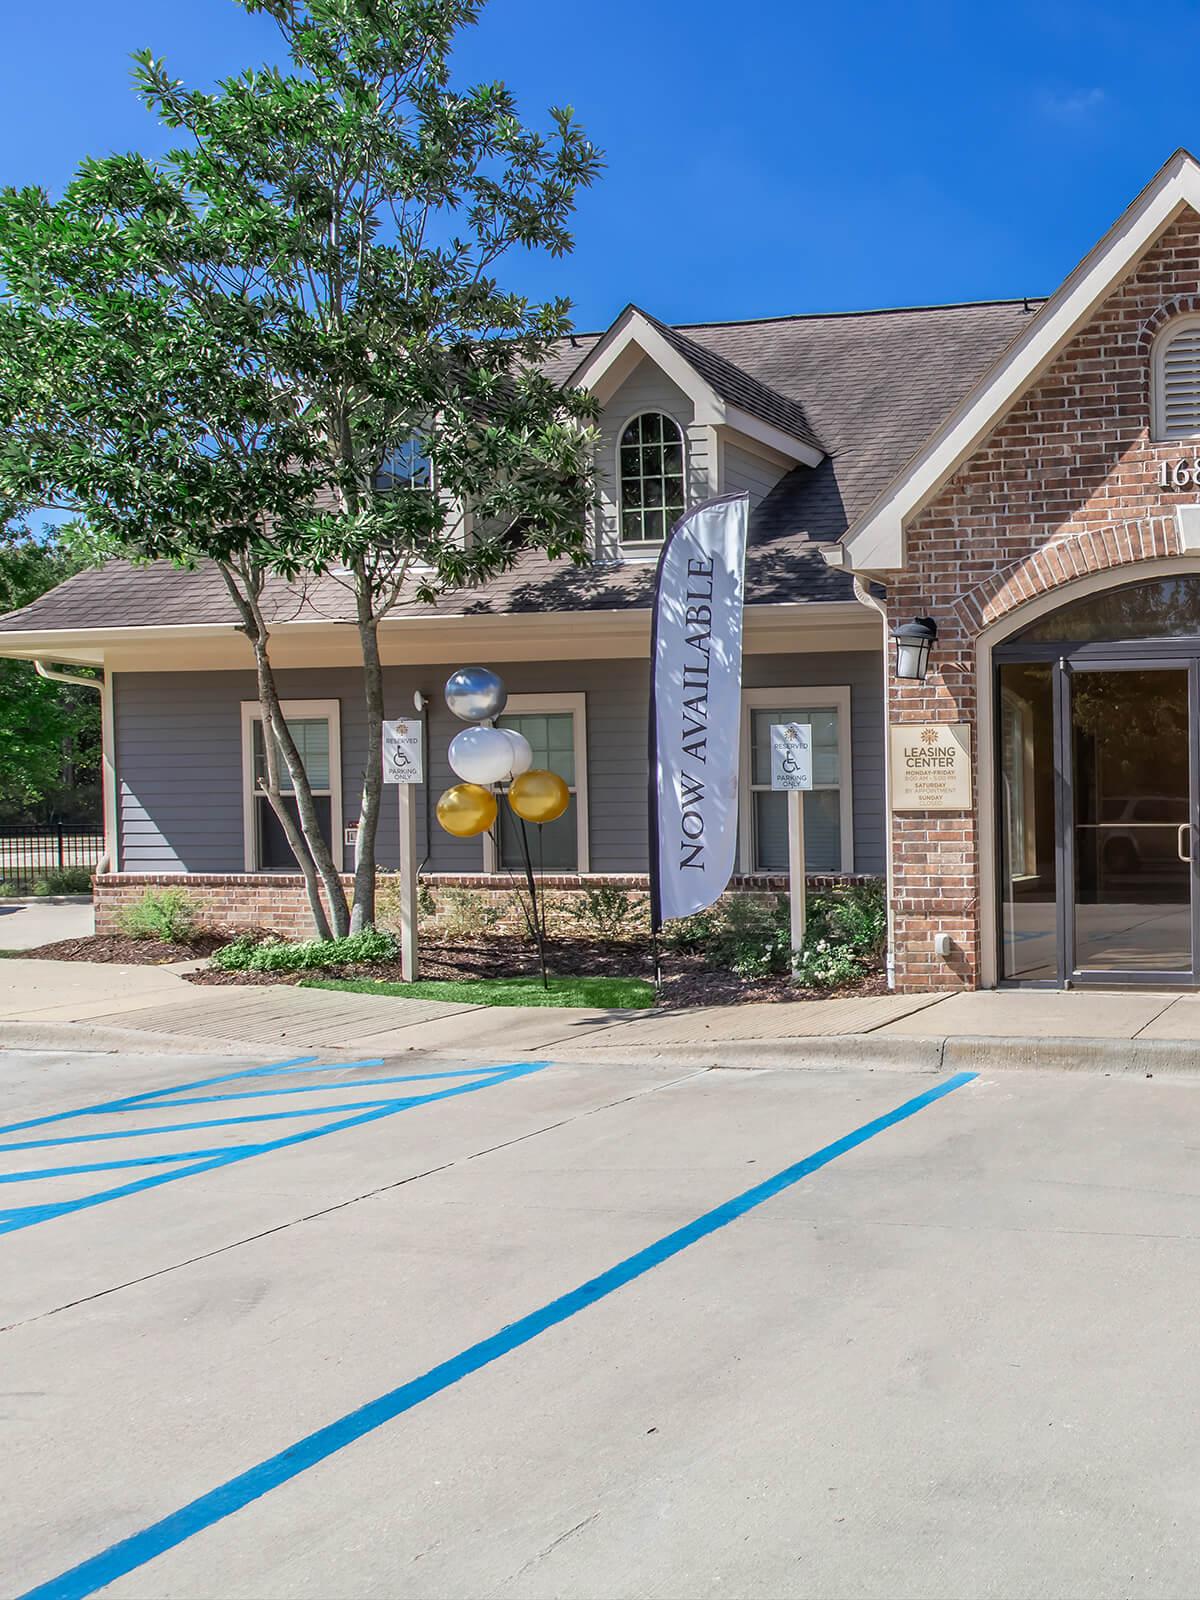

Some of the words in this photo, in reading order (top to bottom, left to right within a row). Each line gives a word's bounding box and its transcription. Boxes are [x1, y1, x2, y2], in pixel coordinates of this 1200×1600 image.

[682, 557, 715, 764] AVAILABLE
[904, 747, 956, 757] LEASING
[906, 757, 954, 768] CENTER
[680, 773, 705, 871] NOW
